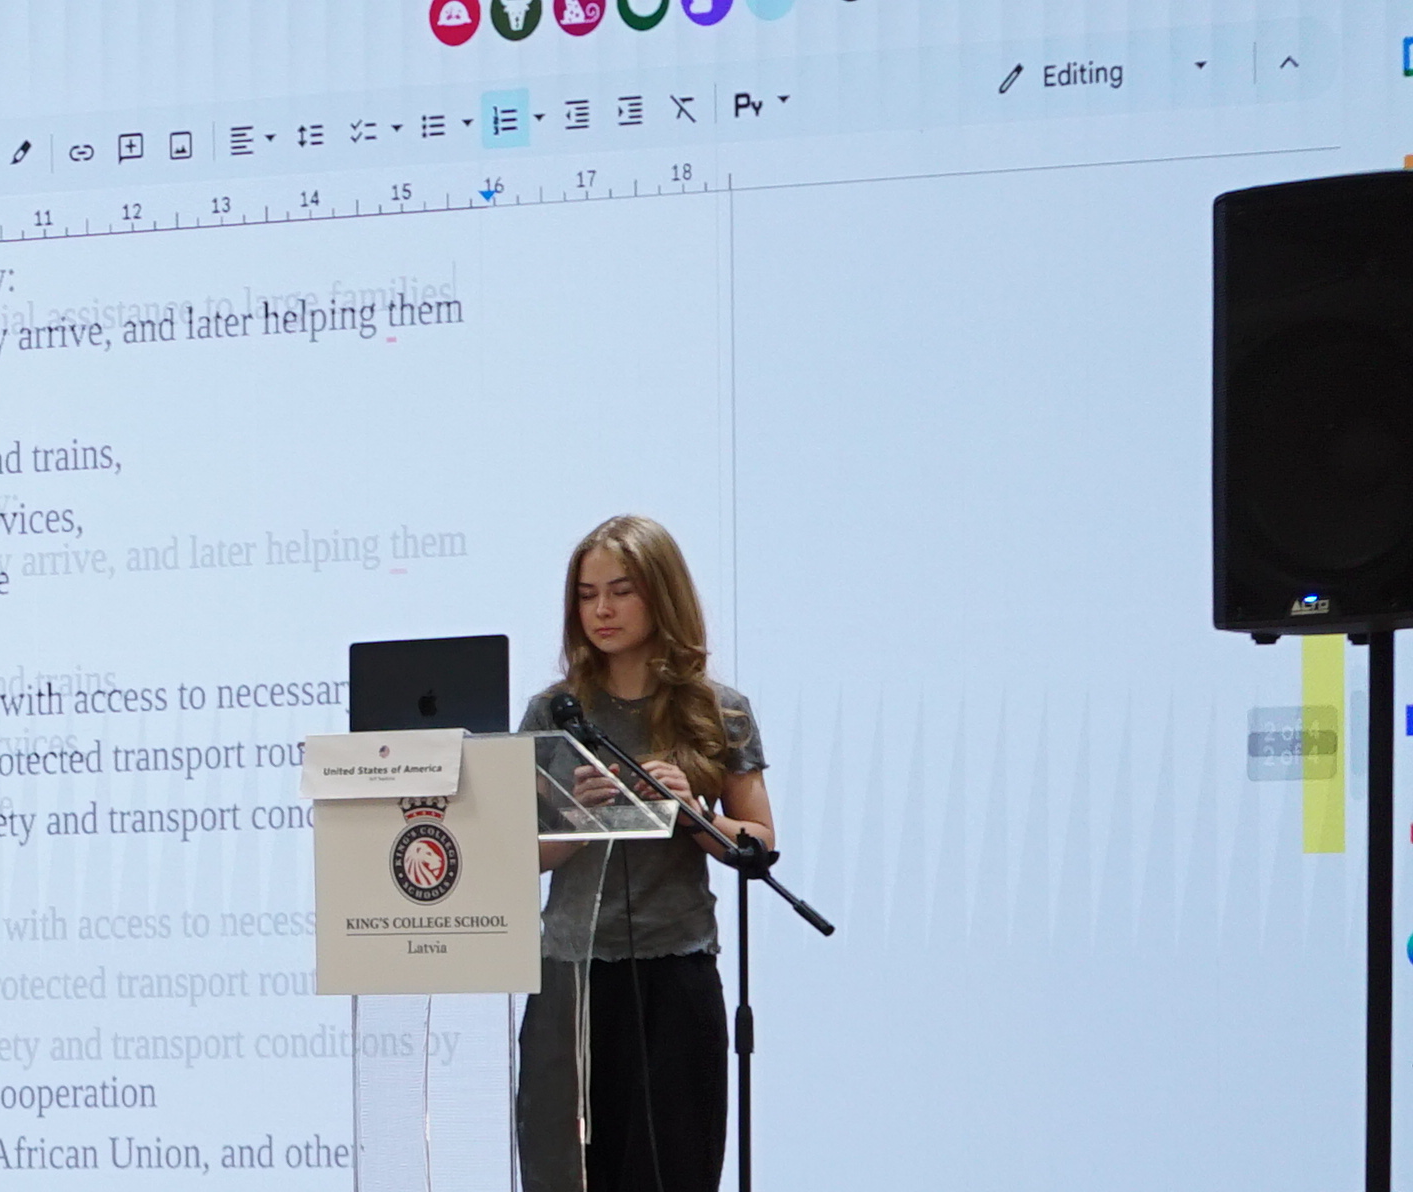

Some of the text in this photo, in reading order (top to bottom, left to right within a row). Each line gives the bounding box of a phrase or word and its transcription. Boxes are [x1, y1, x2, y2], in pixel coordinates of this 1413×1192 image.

[1043, 61, 1124, 90] Editing
[18, 316, 112, 352] arrive,
[123, 308, 174, 344] and
[186, 305, 254, 341] later
[262, 299, 378, 343] helping
[387, 293, 464, 328] them
[32, 439, 122, 474] trains,
[0, 682, 65, 716] with
[74, 687, 168, 714] access
[178, 684, 206, 711] to
[113, 741, 245, 780] transport
[323, 764, 442, 776] United States of America
[47, 801, 98, 835] and
[109, 803, 242, 842] transport
[419, 827, 456, 865] COLLEGE
[403, 881, 450, 899] SCHOOLS
[346, 915, 508, 929] KING'S COLLEGE SCHOOL
[407, 940, 448, 954] Latvia
[110, 1136, 209, 1173] Union,
[221, 1134, 274, 1169] and
